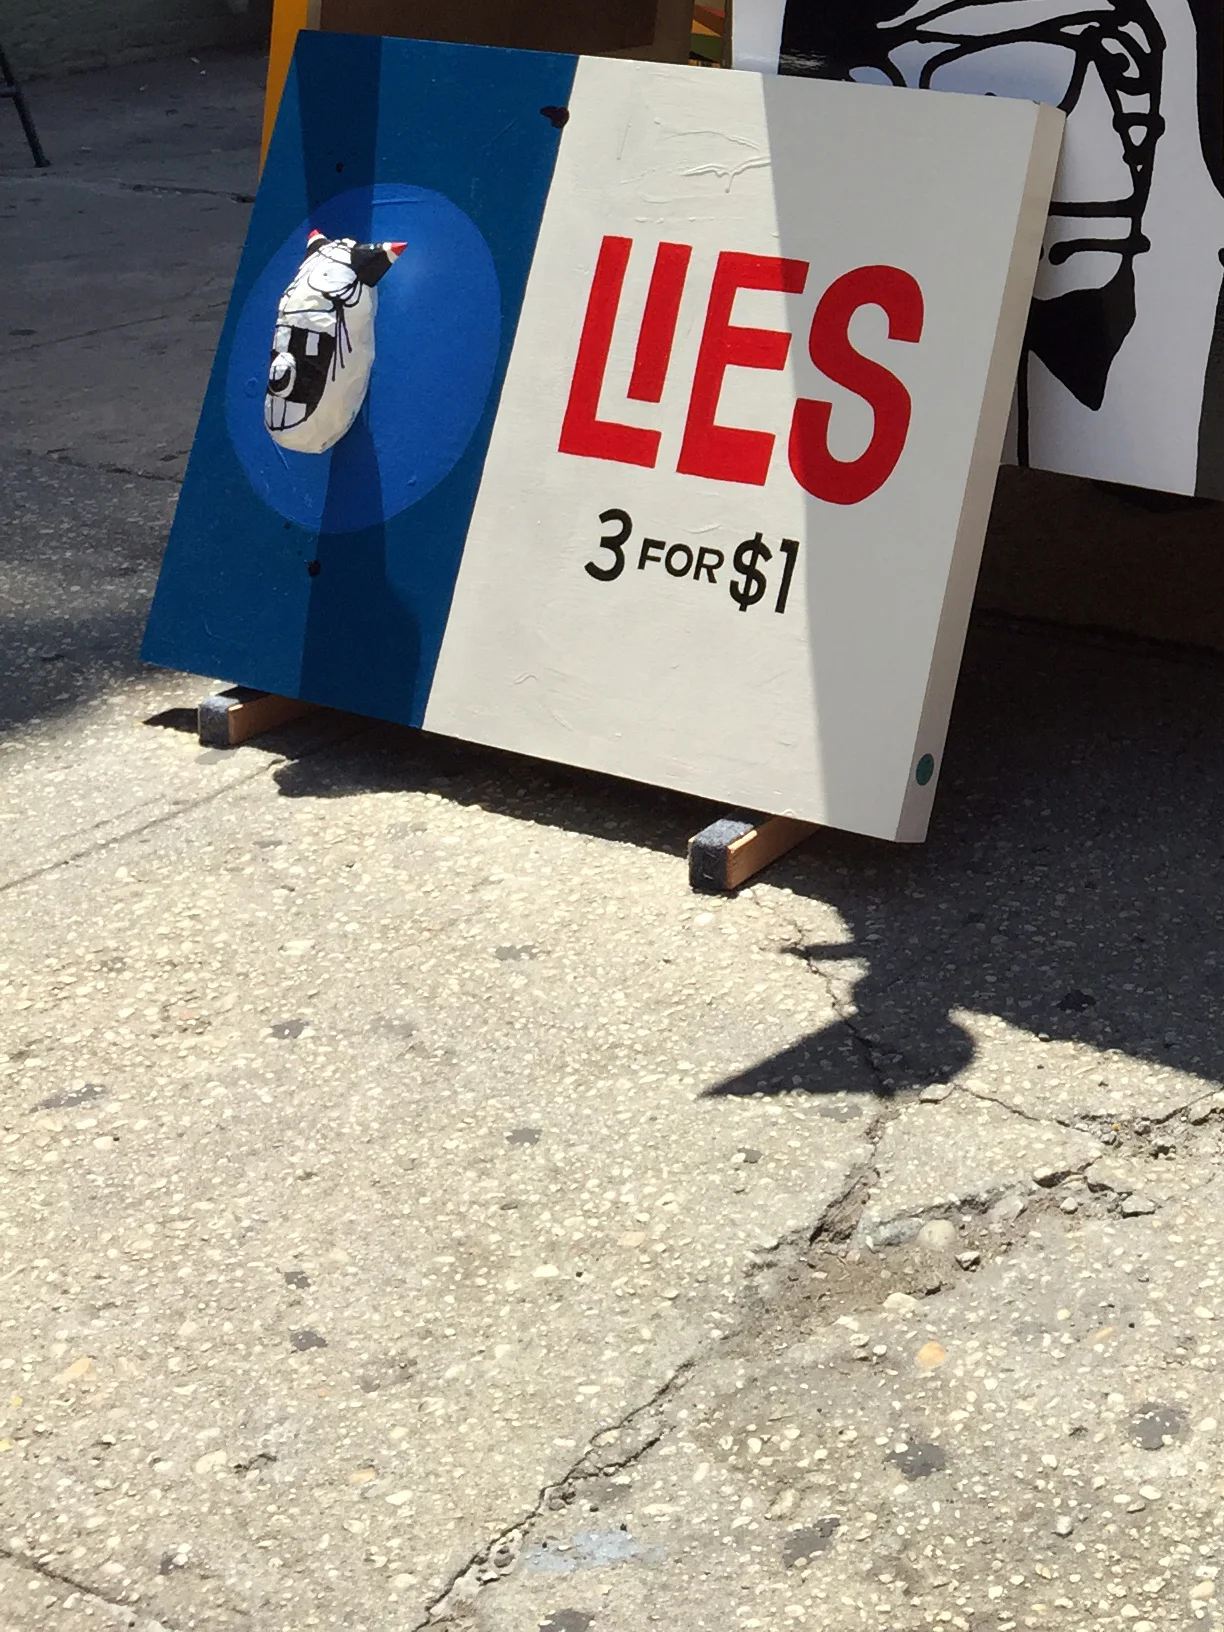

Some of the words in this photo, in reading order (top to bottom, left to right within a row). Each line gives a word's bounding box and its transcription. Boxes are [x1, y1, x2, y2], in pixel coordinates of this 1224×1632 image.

[558, 234, 925, 505] LIES
[584, 508, 633, 582] 3
[637, 537, 725, 584] FOR
[729, 532, 800, 614] $1
